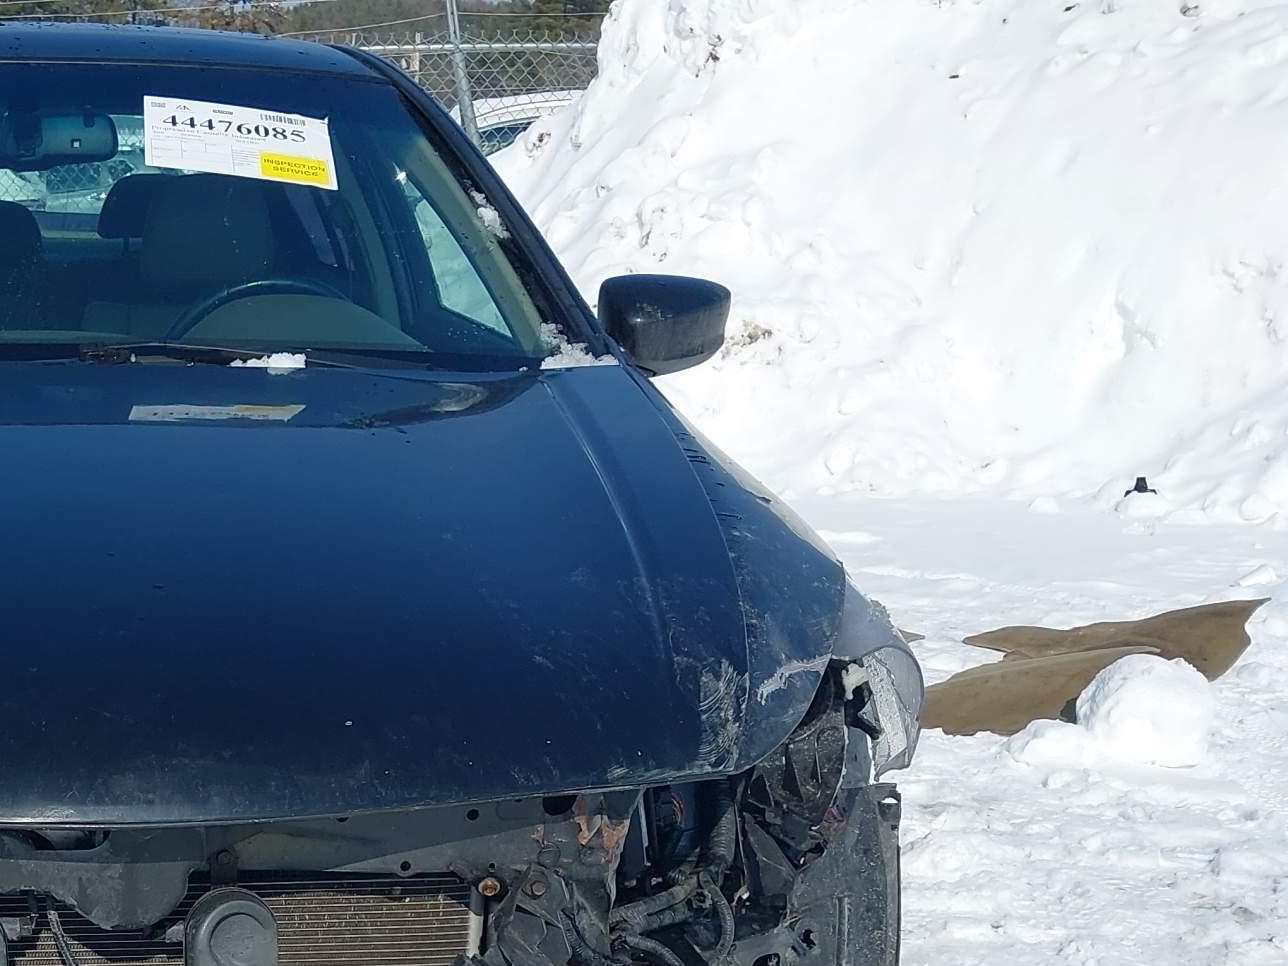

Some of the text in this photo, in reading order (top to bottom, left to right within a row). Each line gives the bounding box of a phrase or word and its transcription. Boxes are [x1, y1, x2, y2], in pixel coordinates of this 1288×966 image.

[162, 114, 306, 143] 44476085
[263, 158, 326, 172] INSPECTION
[272, 166, 319, 177] SERVICE
